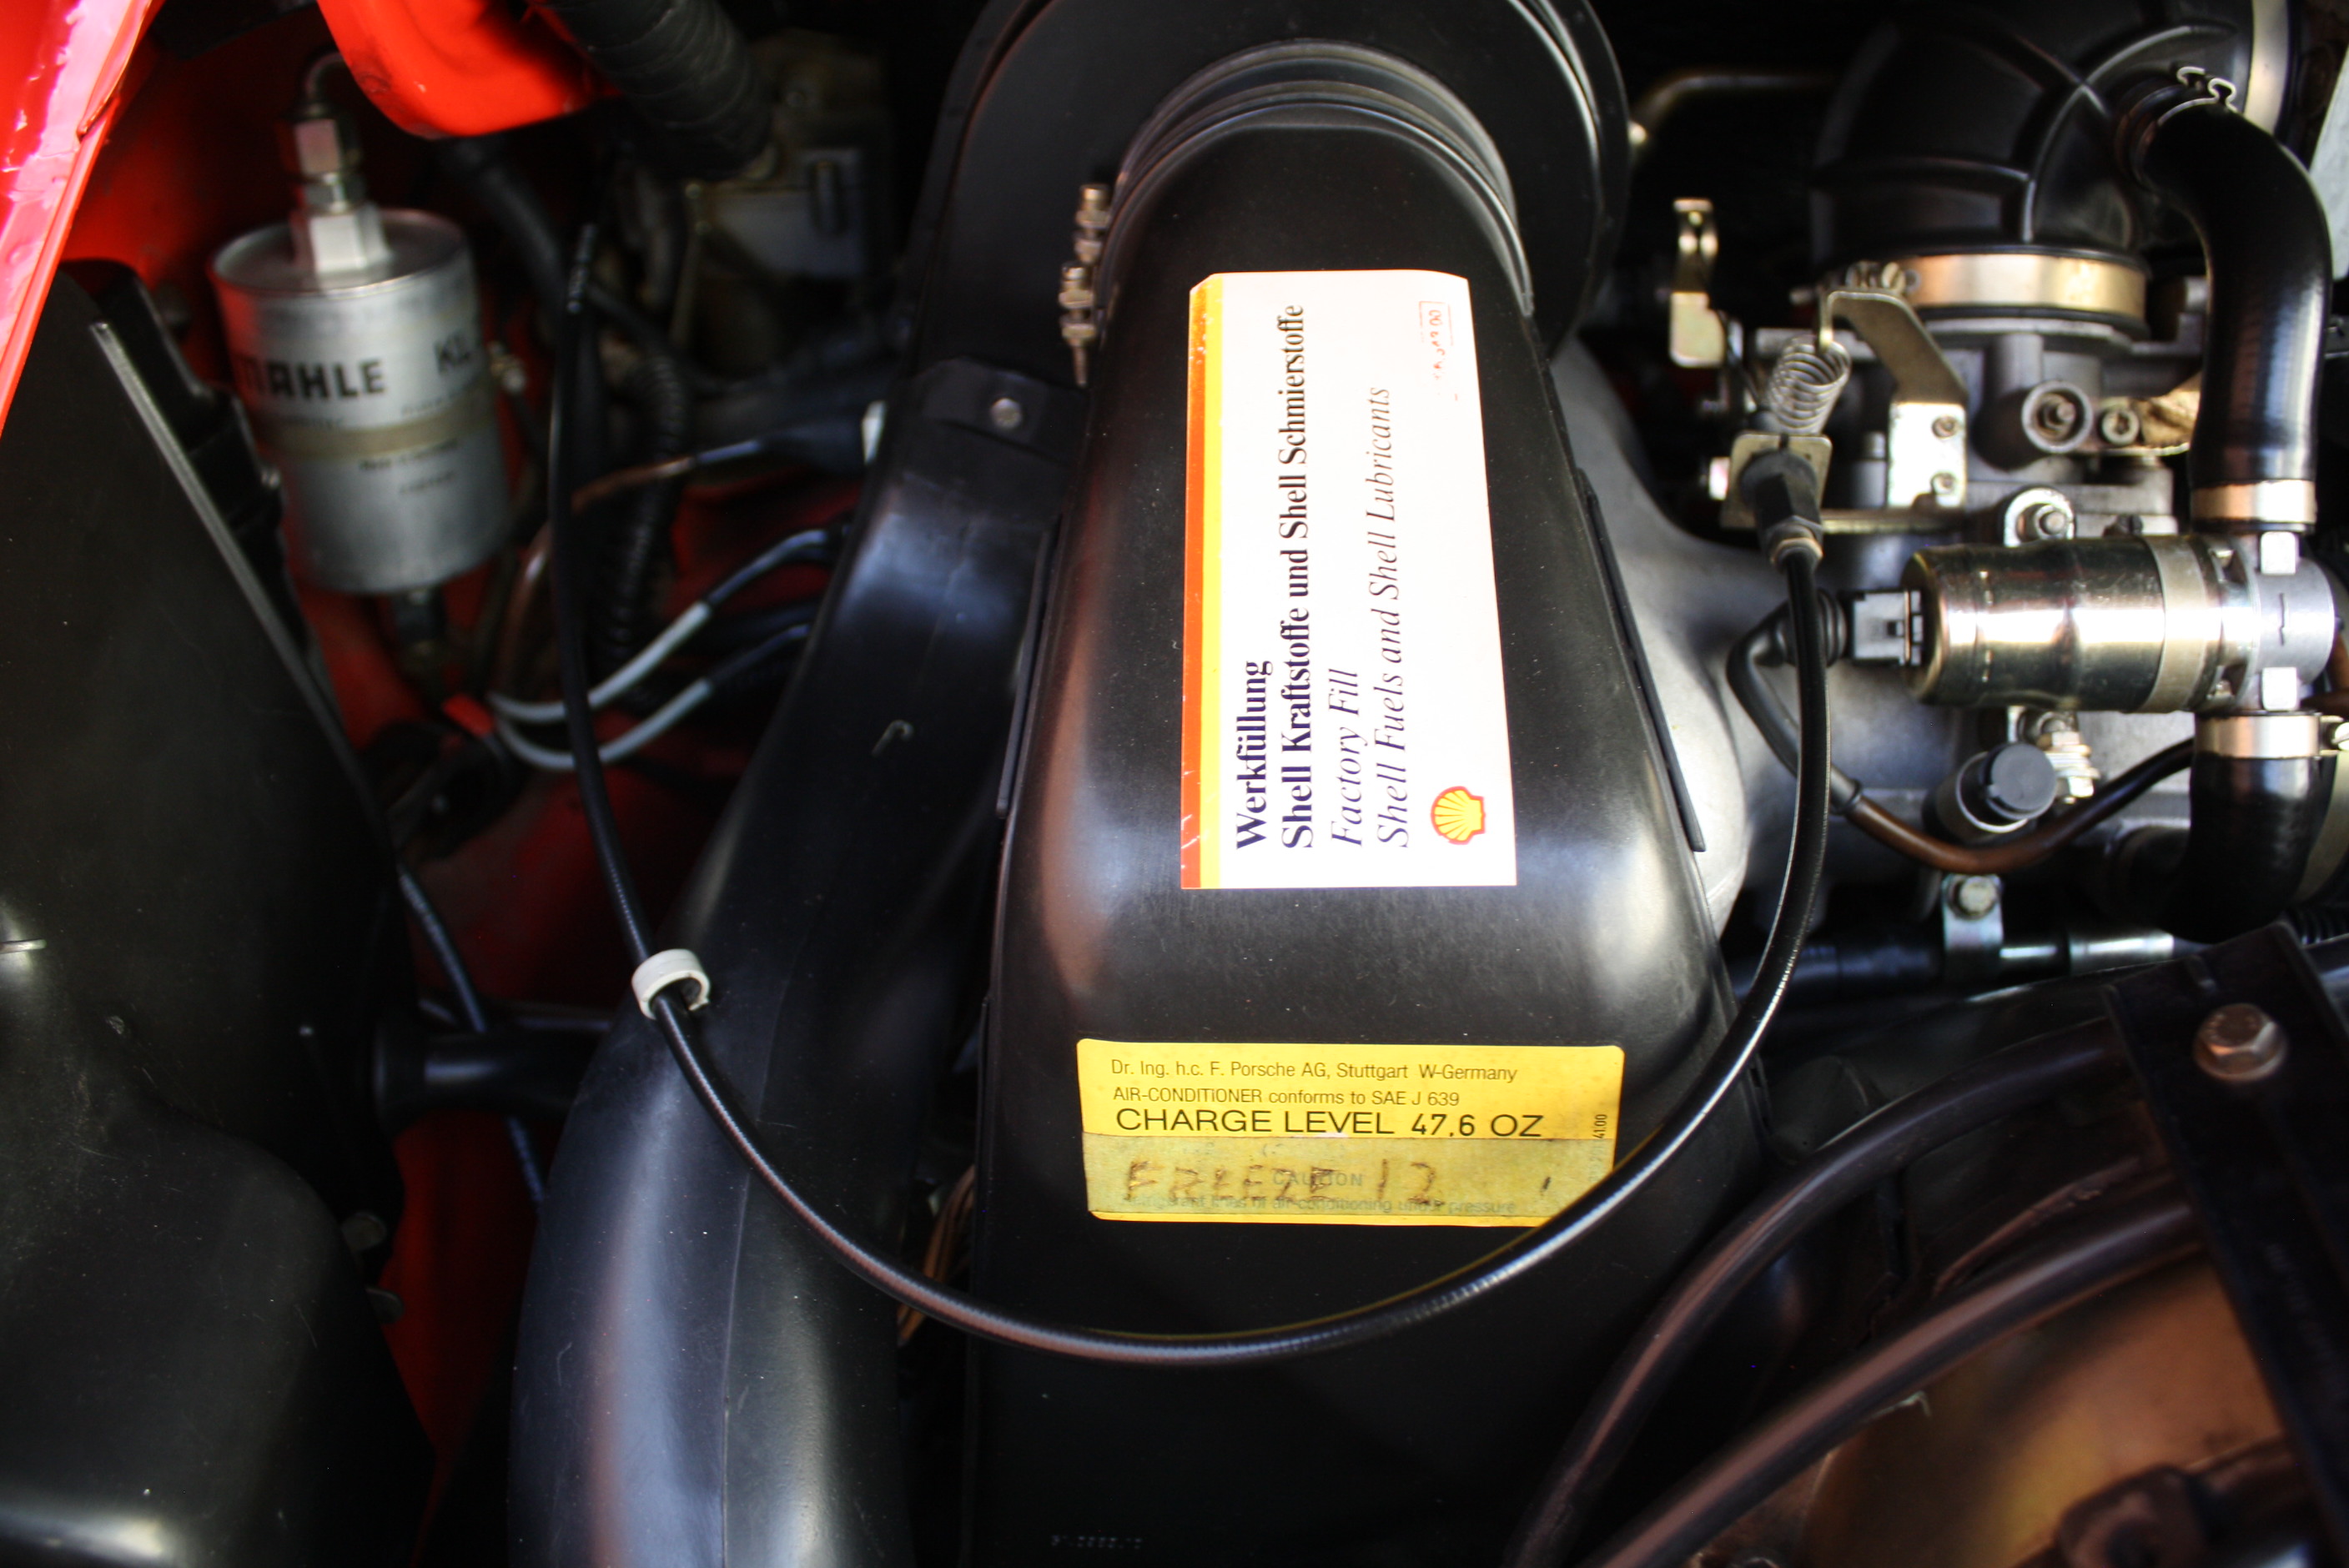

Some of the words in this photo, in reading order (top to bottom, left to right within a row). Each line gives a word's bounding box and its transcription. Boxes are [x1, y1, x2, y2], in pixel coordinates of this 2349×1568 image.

[239, 354, 385, 399] MAHLE
[1277, 304, 1306, 465] Schmierstoffe
[1365, 386, 1396, 521] Lubricants
[1278, 474, 1308, 539] Shell
[1280, 548, 1309, 597] und
[1367, 530, 1399, 601] Shell
[1371, 607, 1402, 664] and
[1280, 608, 1311, 752] Kraftstoffe
[1328, 667, 1359, 716] Fill
[1373, 674, 1406, 751] Fuels
[1236, 660, 1273, 849] Werkfüllung
[1330, 726, 1367, 847] Factory
[1280, 766, 1313, 848] Shell
[1376, 761, 1409, 848] Shell
[1112, 1059, 1134, 1075] Dr.
[1140, 1061, 1169, 1078] Ing.
[1176, 1061, 1204, 1076] h.c.
[1210, 1062, 1225, 1076] F.
[1231, 1062, 1295, 1077] Porsche
[1301, 1063, 1330, 1080] AG,
[1336, 1063, 1408, 1082] Stuttgart
[1418, 1064, 1517, 1083] W-Germany
[1113, 1087, 1262, 1103] AIR-CONDITIONER
[1269, 1089, 1345, 1105] conforms
[1351, 1091, 1366, 1105] to
[1371, 1091, 1406, 1105] SAE
[1411, 1092, 1421, 1105] J
[1427, 1092, 1460, 1107] 639
[1116, 1108, 1272, 1133] CHARGE
[1285, 1110, 1395, 1134] LEVEL
[1490, 1113, 1544, 1137] OZ
